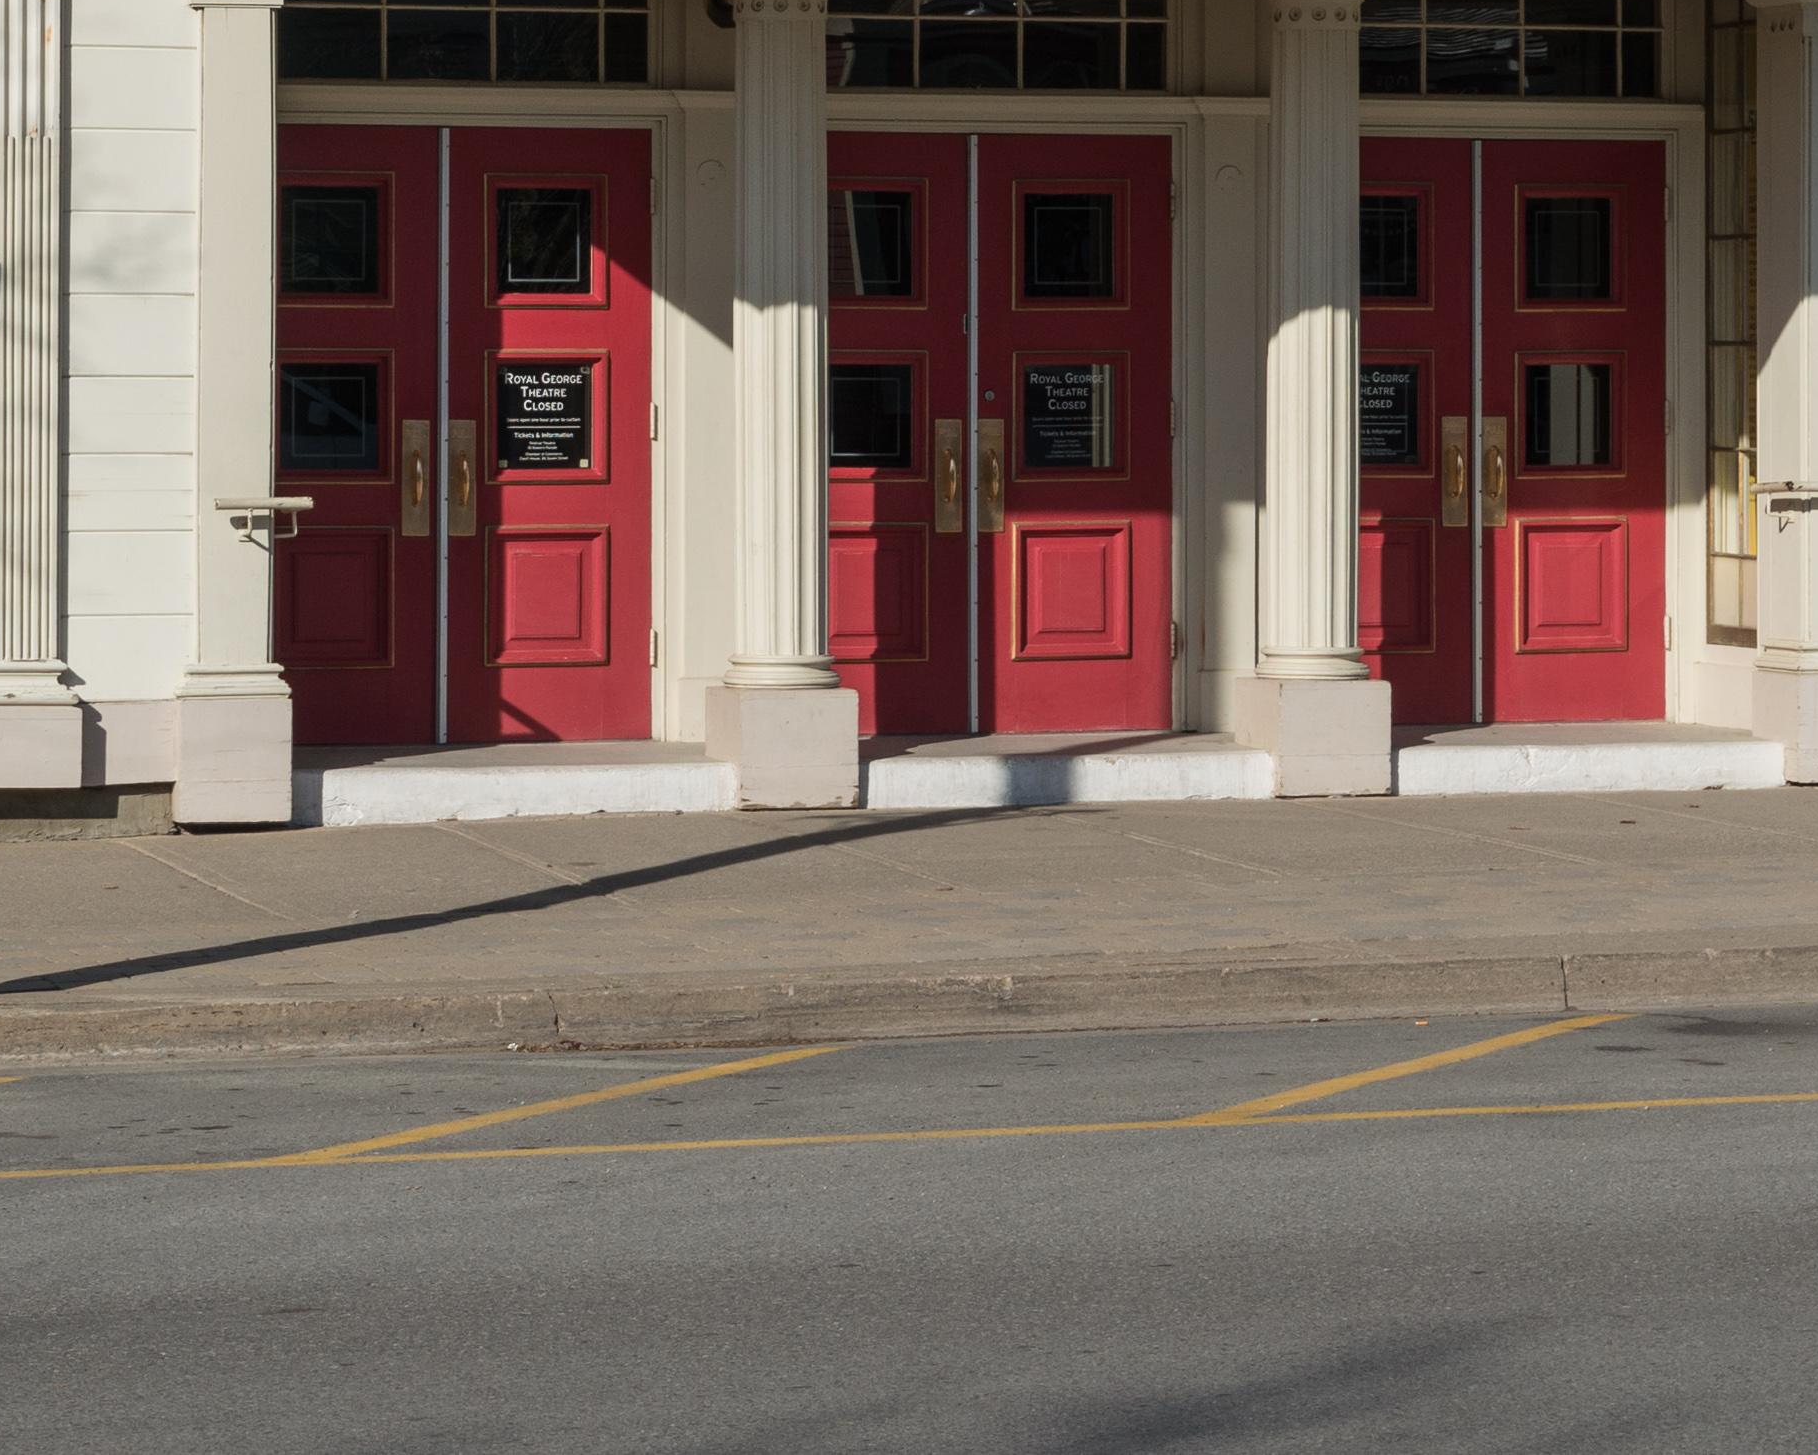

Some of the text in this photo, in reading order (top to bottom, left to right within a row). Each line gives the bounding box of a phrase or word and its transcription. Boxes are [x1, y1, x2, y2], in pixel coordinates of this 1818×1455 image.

[505, 373, 582, 384] ROYAL GEORGE
[1030, 373, 1104, 384] ROYAL GEORGE
[1372, 372, 1410, 383] GEORGE
[520, 386, 567, 398] THEATRE
[1045, 386, 1089, 397] THEATRE
[1360, 387, 1396, 395] HEATRE
[524, 400, 564, 411] CLOSED
[1048, 399, 1086, 410] CLOSED
